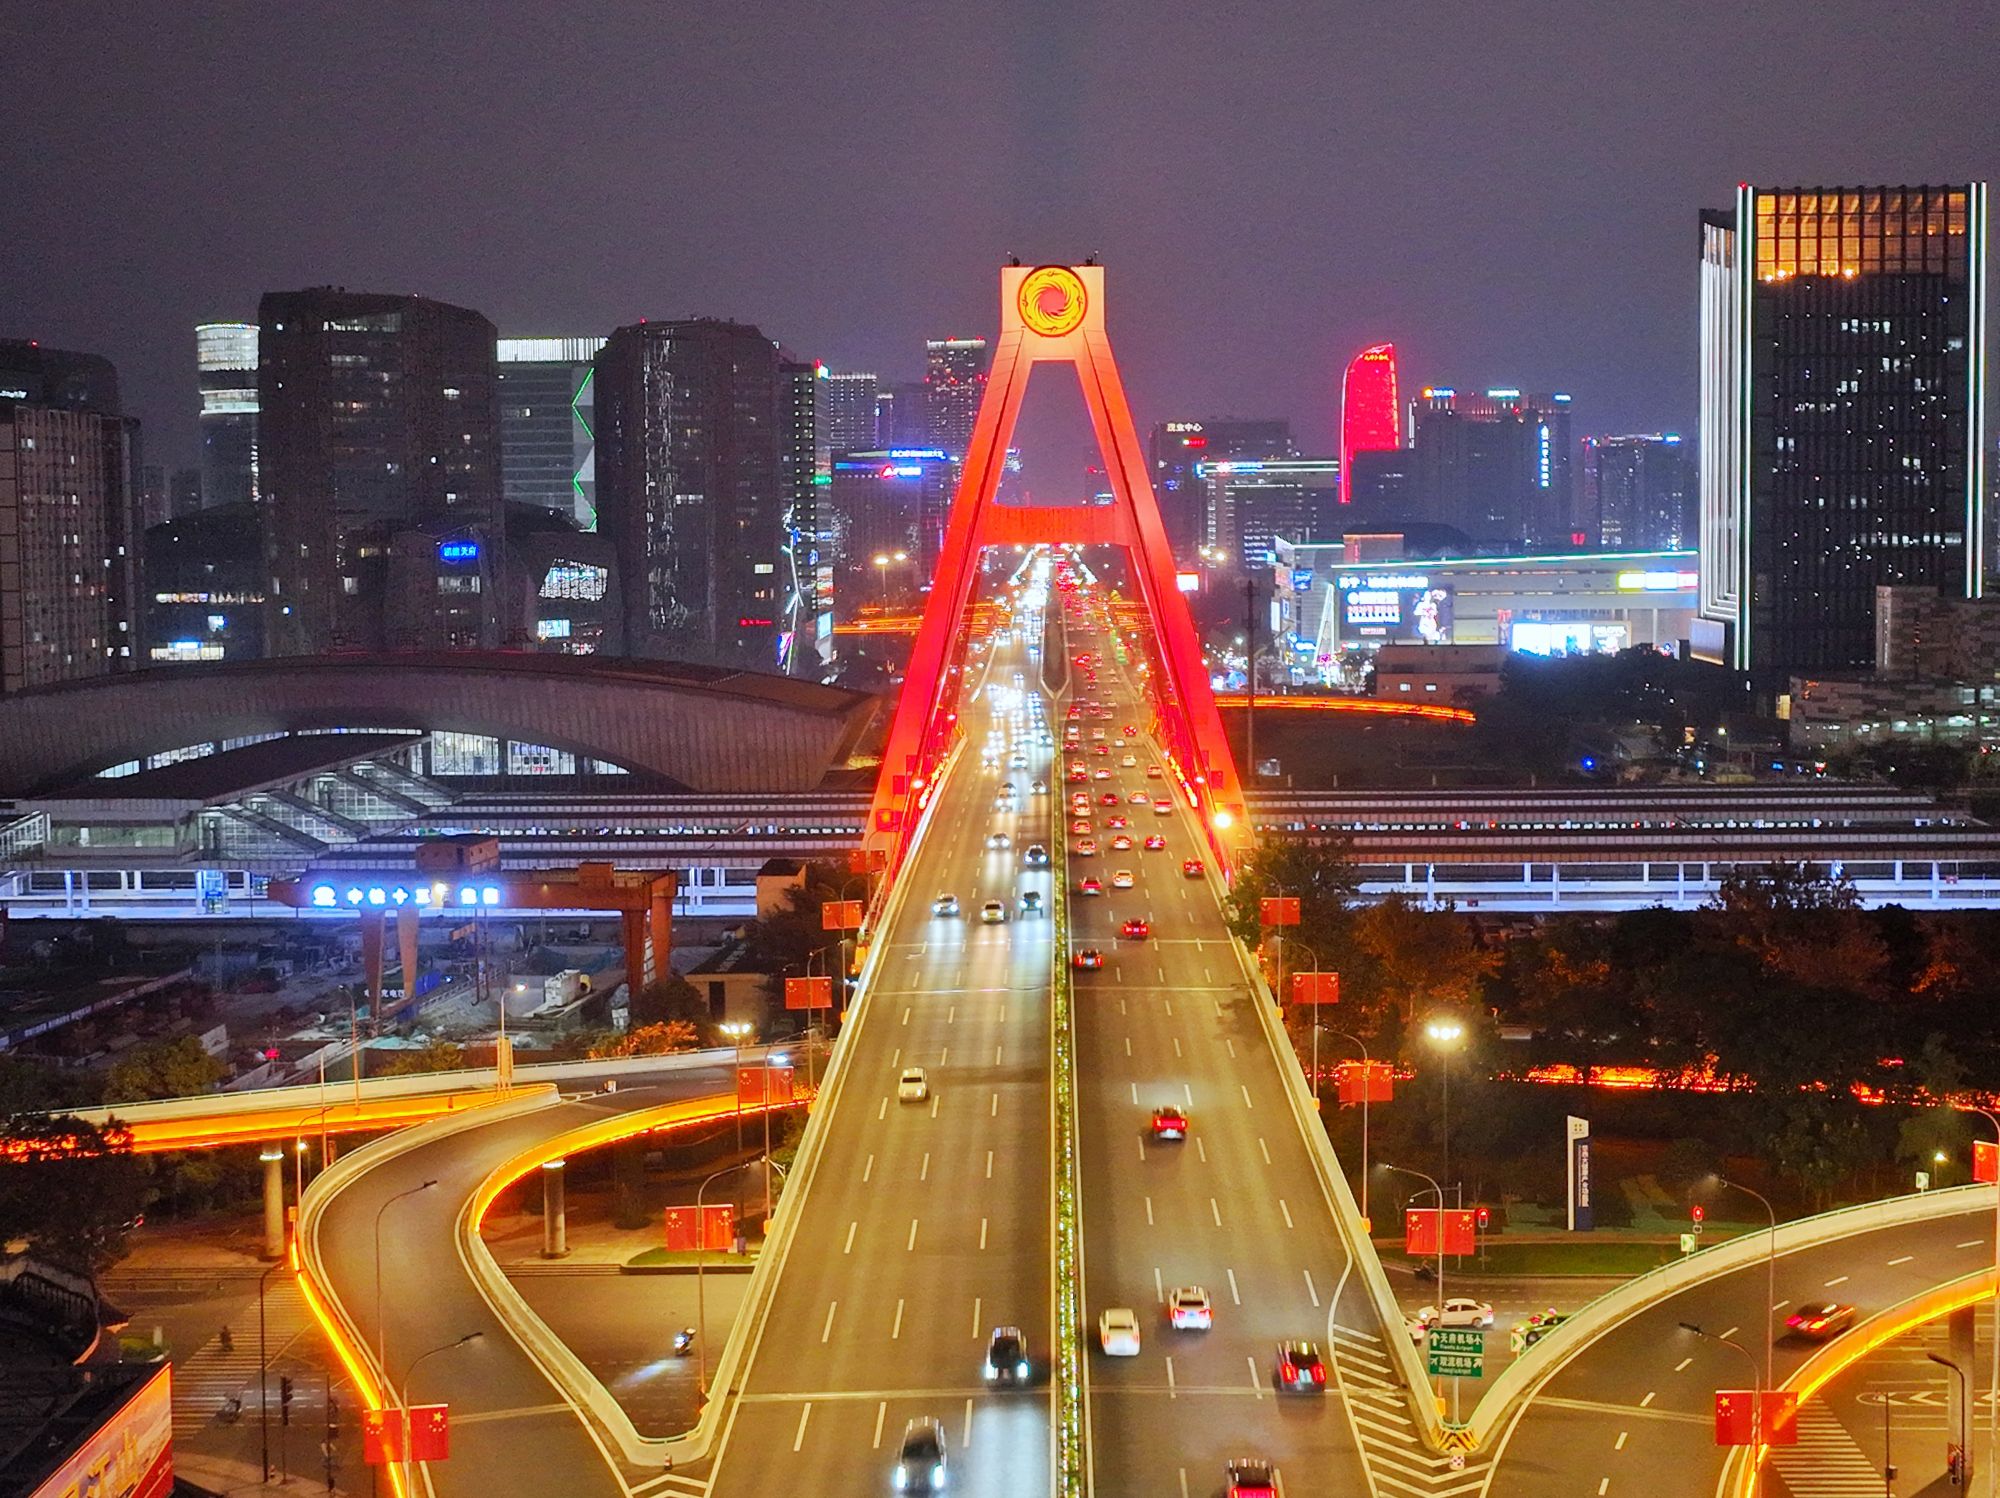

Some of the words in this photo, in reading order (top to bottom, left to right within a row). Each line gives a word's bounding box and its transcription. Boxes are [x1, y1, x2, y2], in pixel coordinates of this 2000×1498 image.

[1440, 1333, 1474, 1344] 天府机场
[1440, 1357, 1472, 1368] 双流机场
